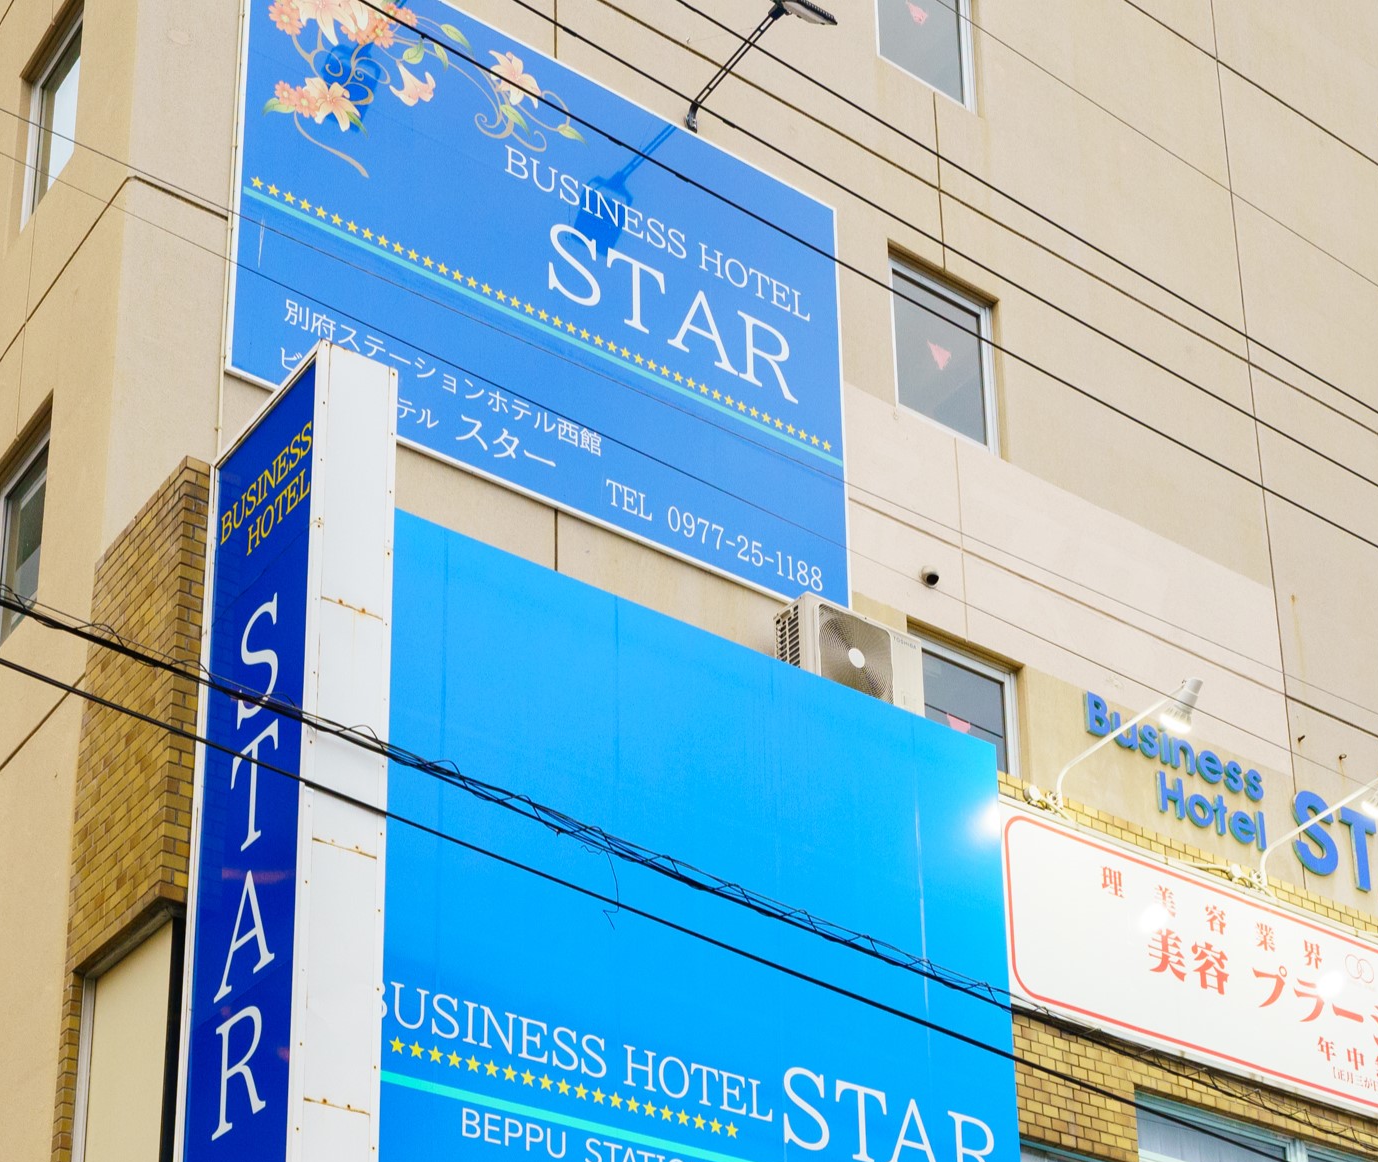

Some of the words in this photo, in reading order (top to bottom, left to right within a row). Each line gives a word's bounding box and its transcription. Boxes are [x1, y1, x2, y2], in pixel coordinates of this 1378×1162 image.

[504, 145, 688, 261] BUSINESS
[697, 242, 811, 321] HOTEL
[548, 223, 799, 405] STAR
[283, 299, 603, 457] 別府ステーションホテル西館
[219, 421, 314, 545] BUSINESS
[455, 413, 557, 470] スター
[246, 470, 311, 556] HOTEL
[607, 479, 652, 521] TEL
[668, 507, 824, 592] 0977-25-1188
[893, 636, 917, 650] TOSHIBA
[1083, 691, 1265, 803] Business
[211, 592, 280, 1141] STAR
[1155, 771, 1268, 853] Hotel
[1148, 927, 1230, 996] 美容
[382, 981, 607, 1079] USINESS
[623, 1044, 773, 1123] HOTEL
[460, 1107, 567, 1160] BEPPU
